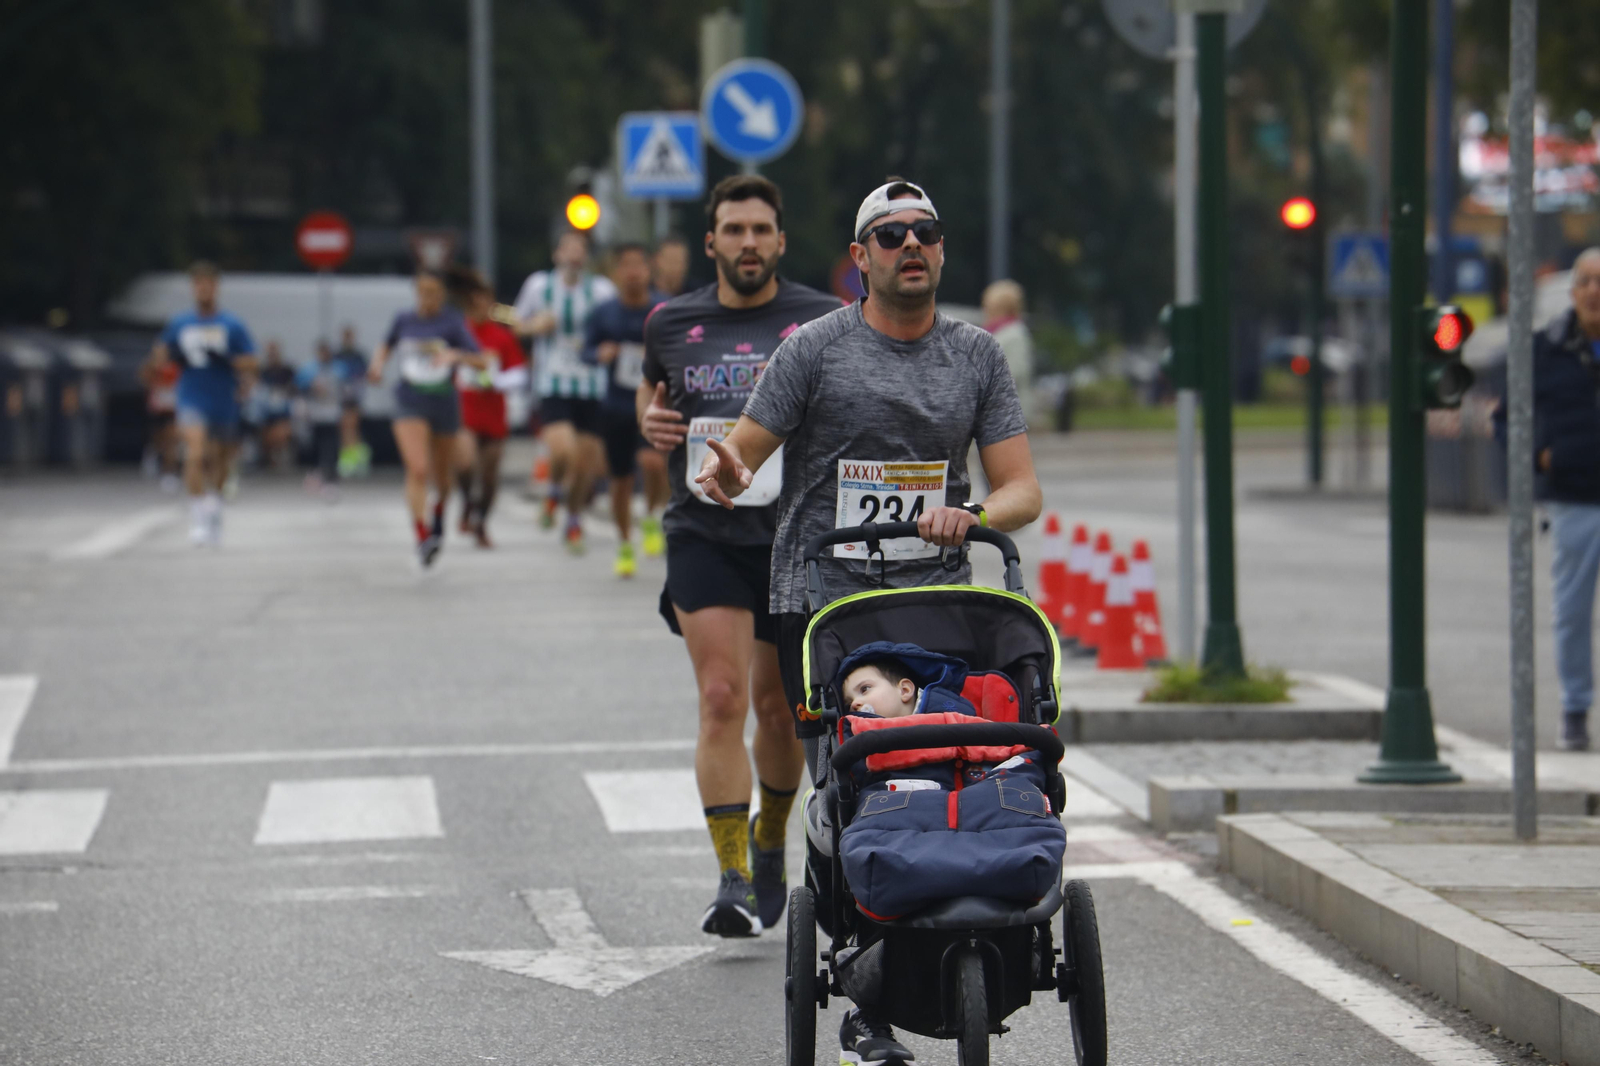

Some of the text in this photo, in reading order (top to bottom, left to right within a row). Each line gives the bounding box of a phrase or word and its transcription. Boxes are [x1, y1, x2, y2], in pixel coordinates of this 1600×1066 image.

[843, 464, 883, 481] XXXIX
[841, 481, 860, 489] Colegio
[860, 495, 925, 525] 234
